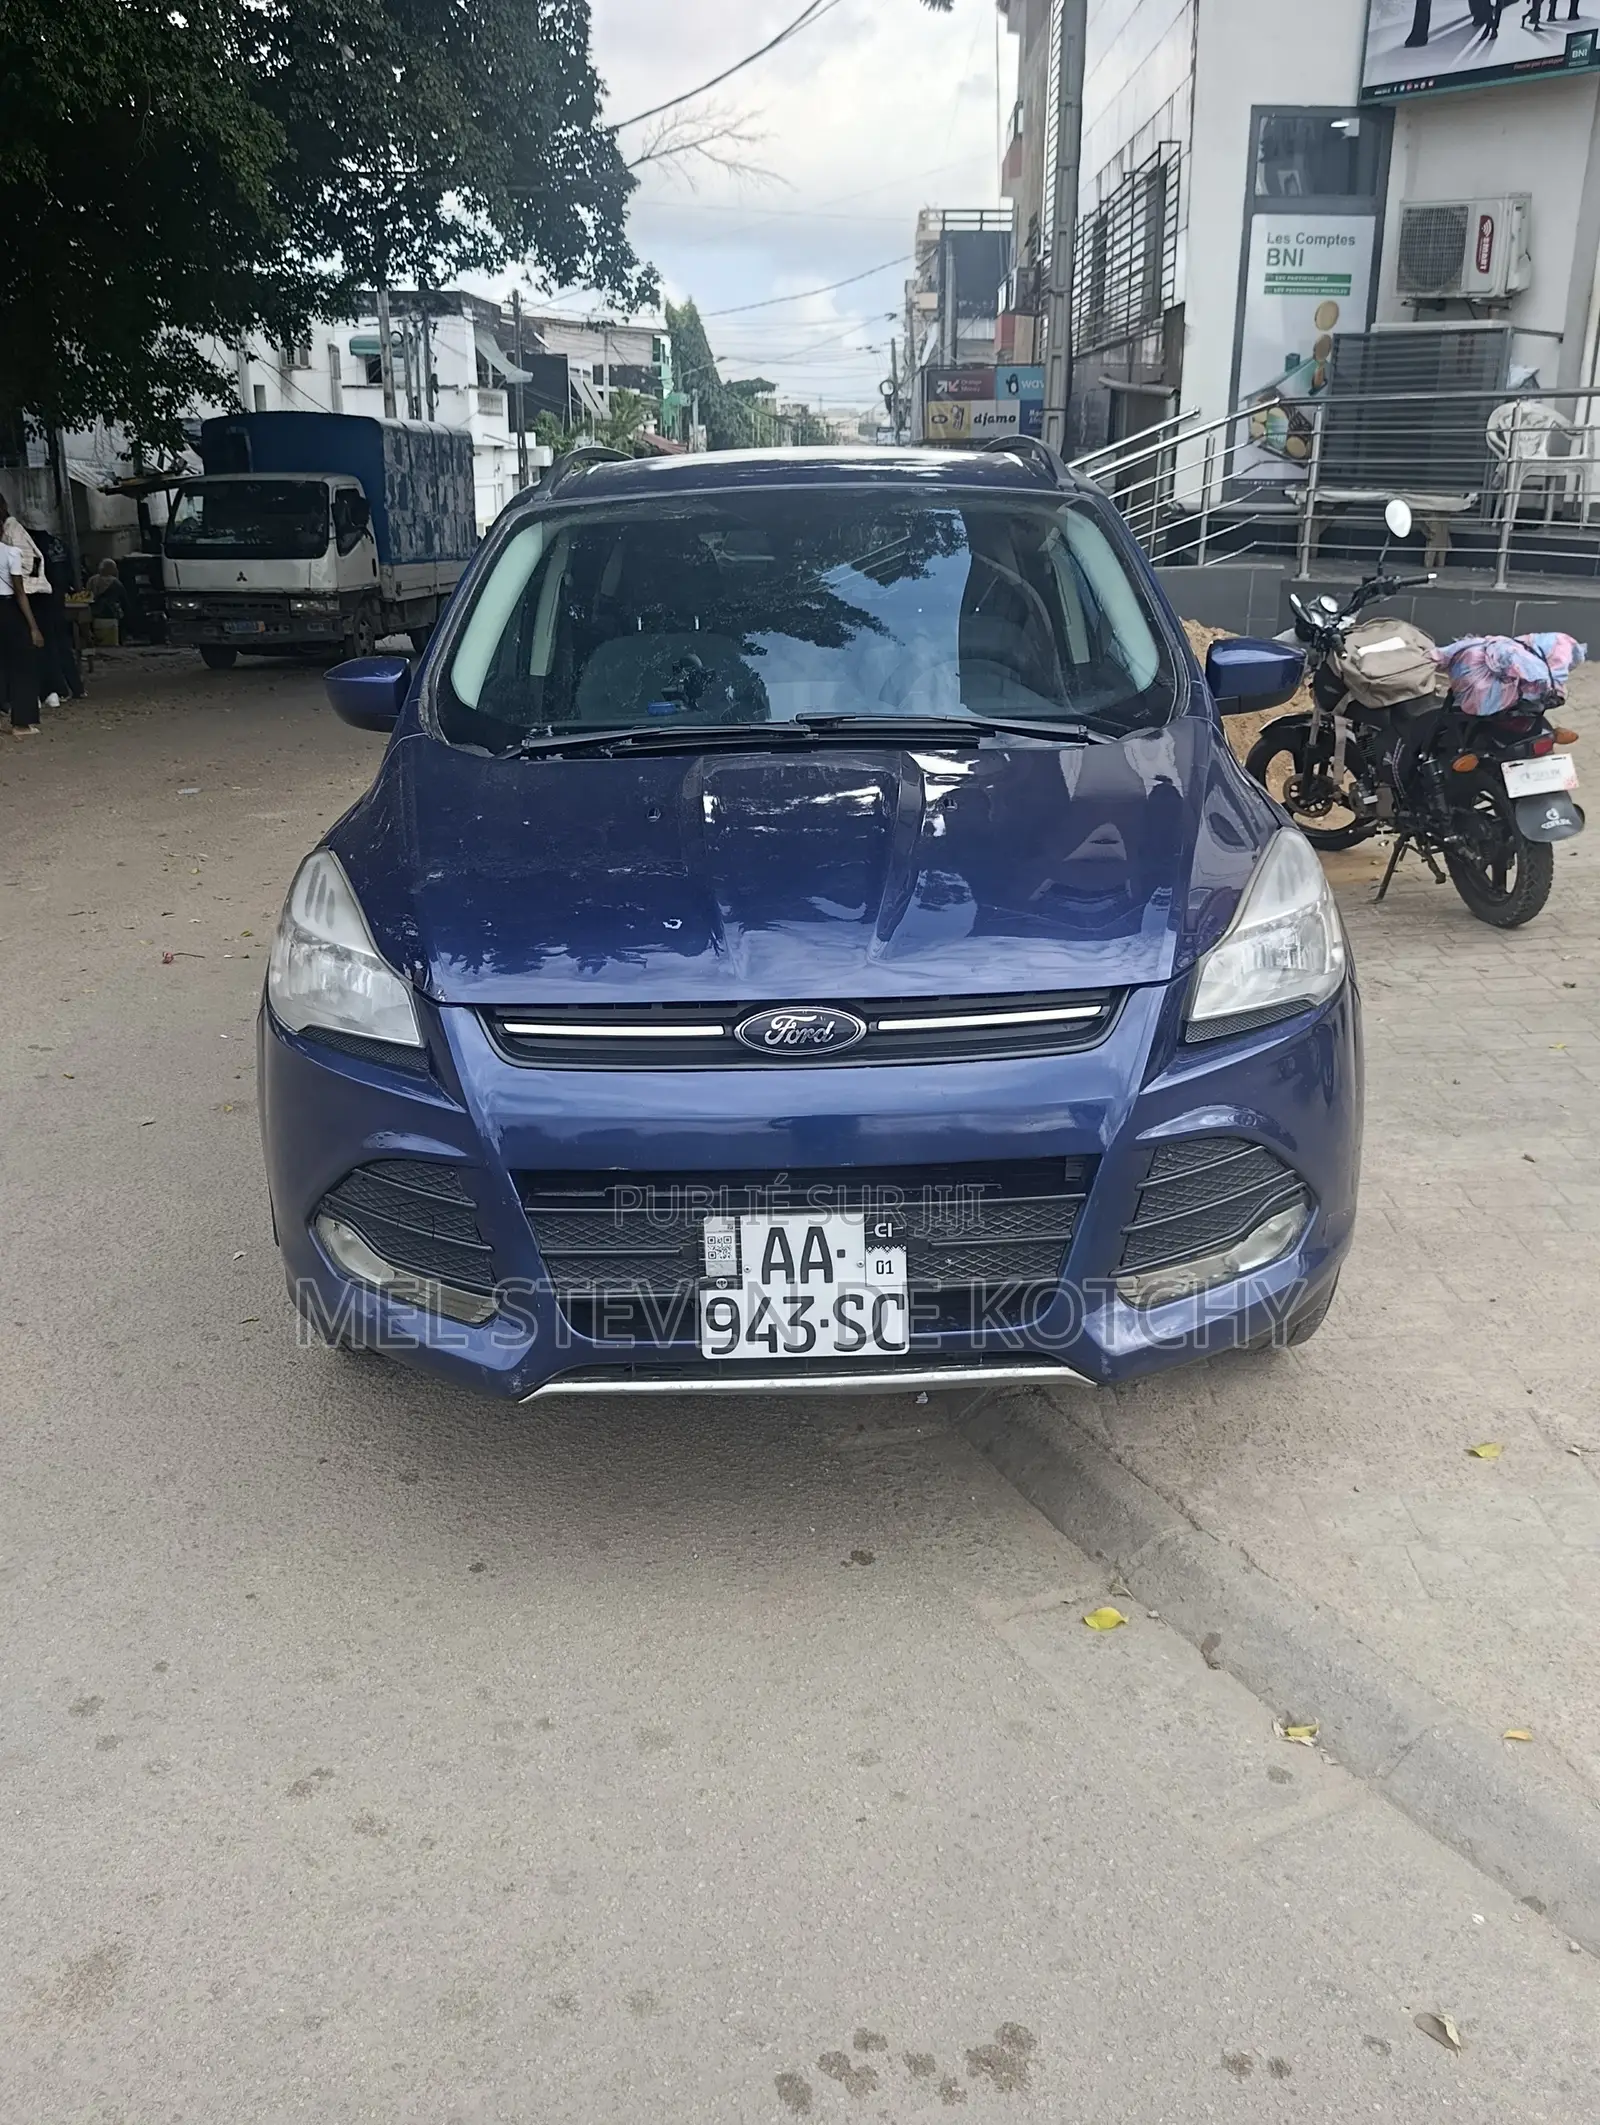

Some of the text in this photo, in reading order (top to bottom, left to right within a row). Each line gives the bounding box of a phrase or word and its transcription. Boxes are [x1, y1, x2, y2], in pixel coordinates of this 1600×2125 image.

[1571, 48, 1588, 59] BNI
[1266, 232, 1356, 249] Les Comptes
[1266, 248, 1304, 267] BNI
[973, 412, 1017, 426] djamo
[764, 1015, 836, 1046] Ford
[874, 1222, 893, 1238] CI
[875, 1259, 895, 1275] 01
